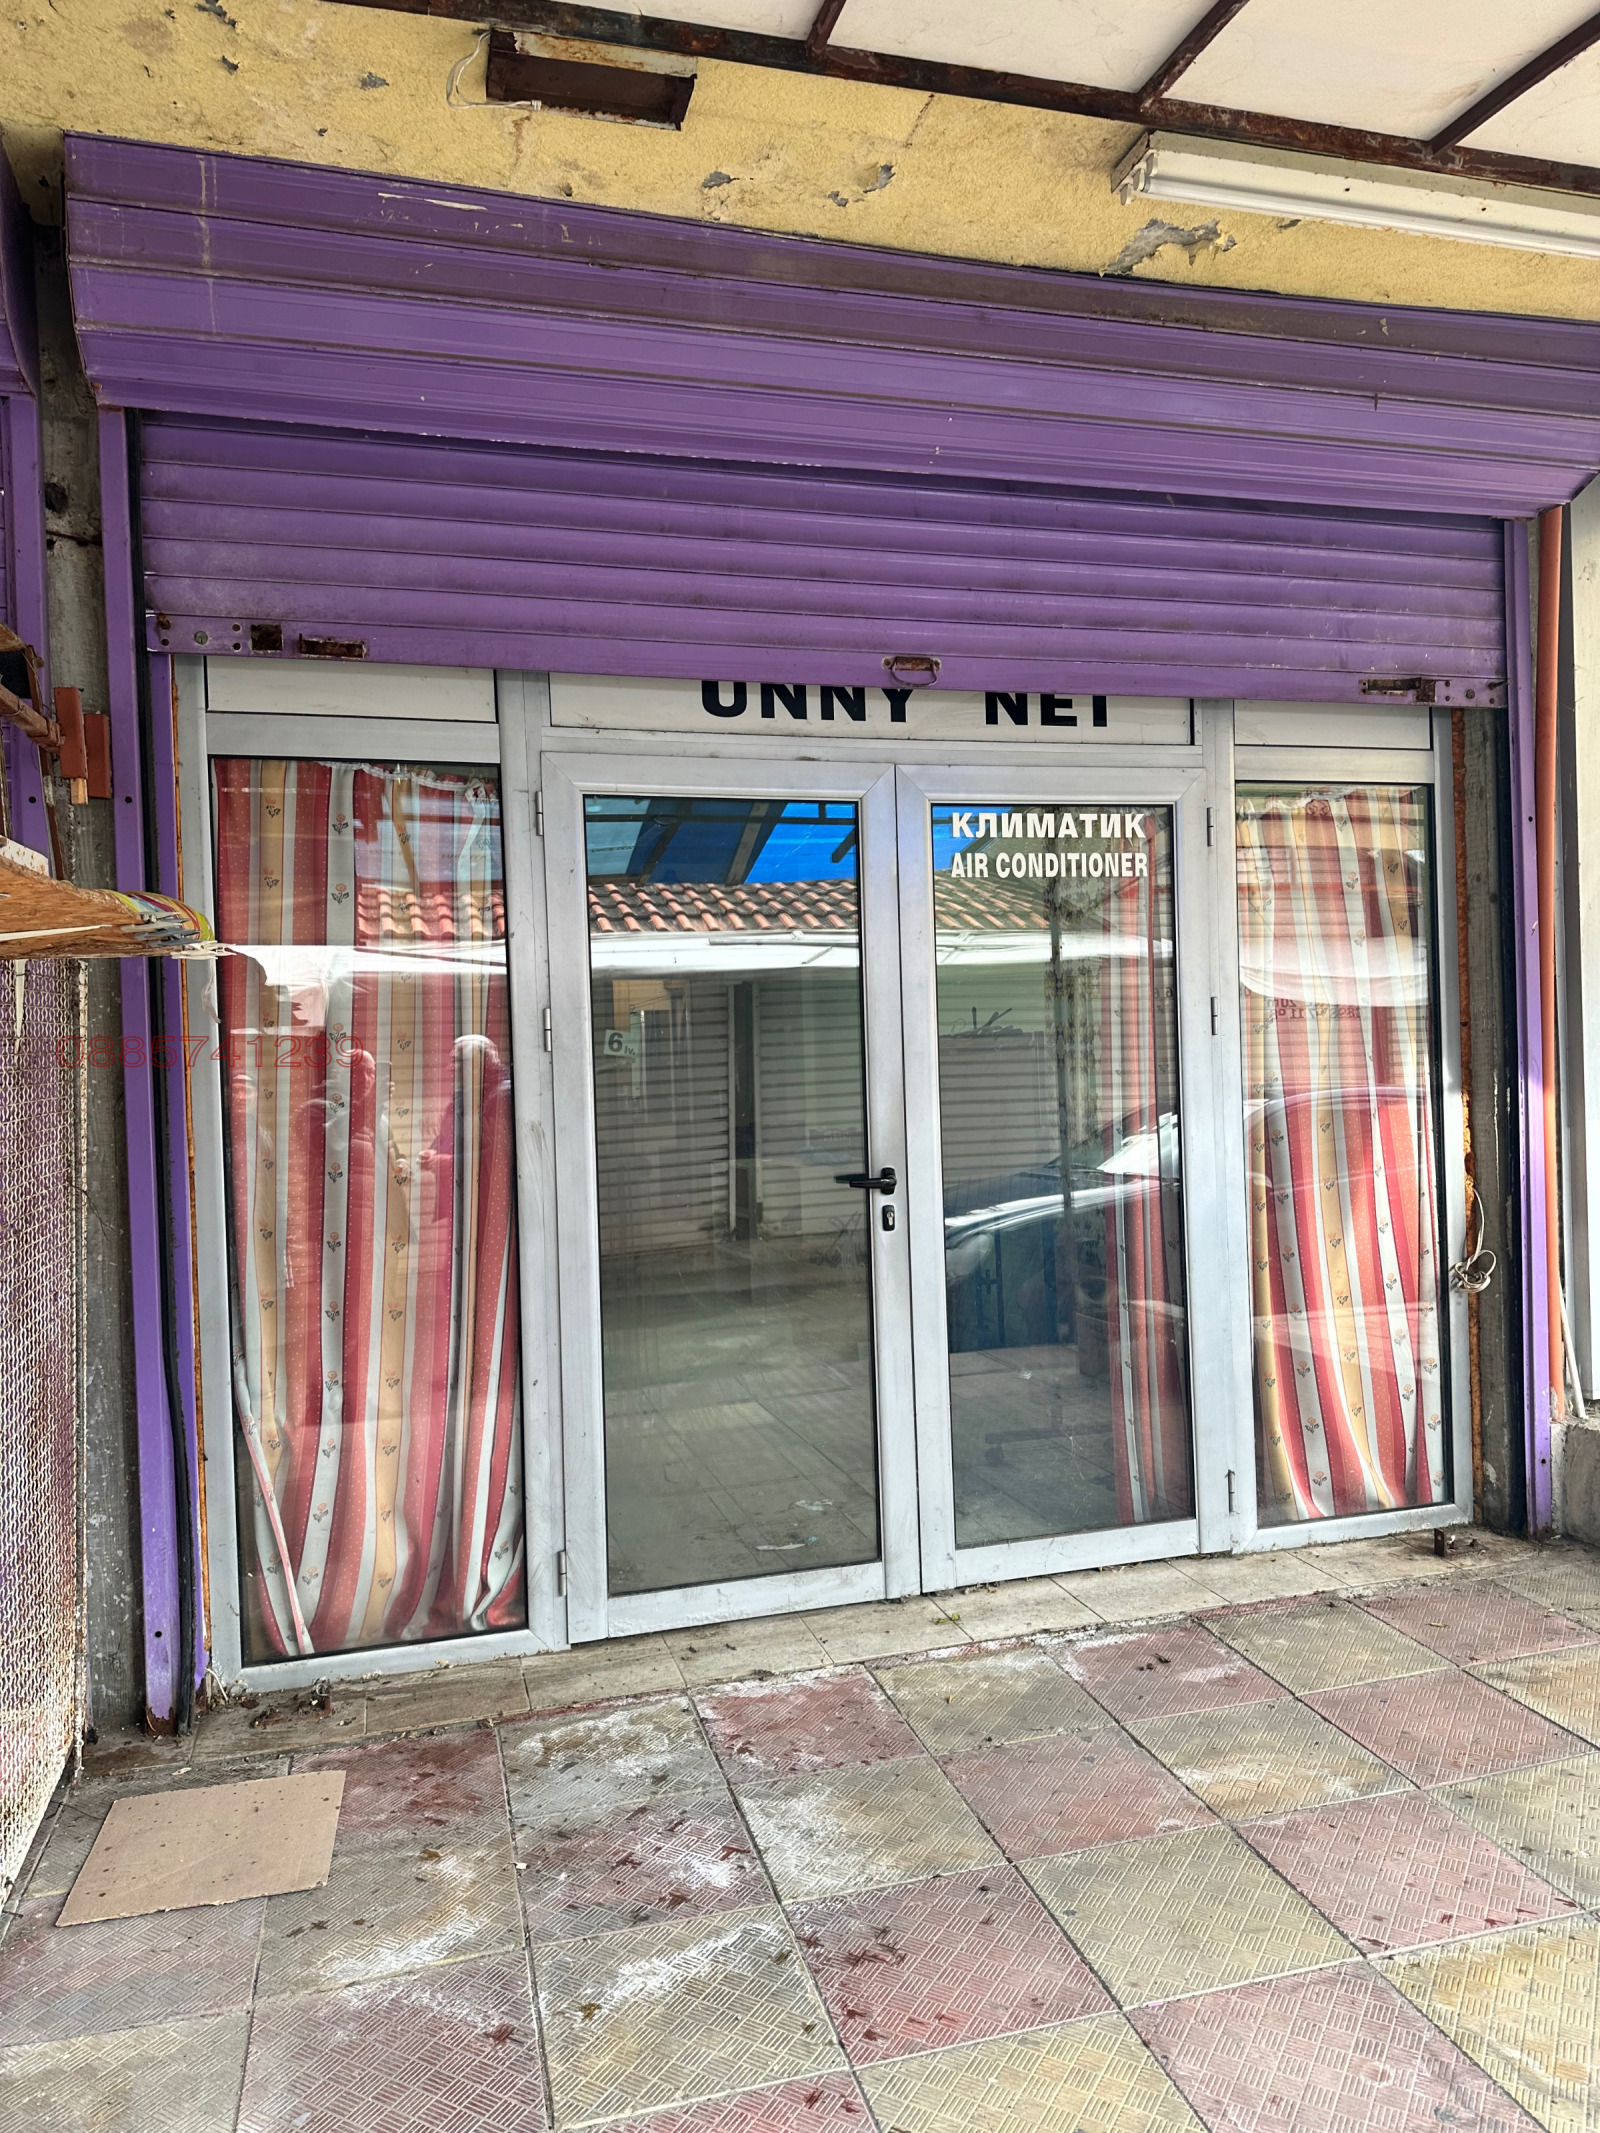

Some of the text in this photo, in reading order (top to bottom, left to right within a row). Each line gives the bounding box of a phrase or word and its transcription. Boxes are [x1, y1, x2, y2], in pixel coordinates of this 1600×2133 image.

[702, 681, 914, 723] UNNY
[952, 812, 1146, 838] КЛИМАТИК
[951, 852, 1148, 878] AIR CONDITIONER
[608, 1032, 623, 1053] 6
